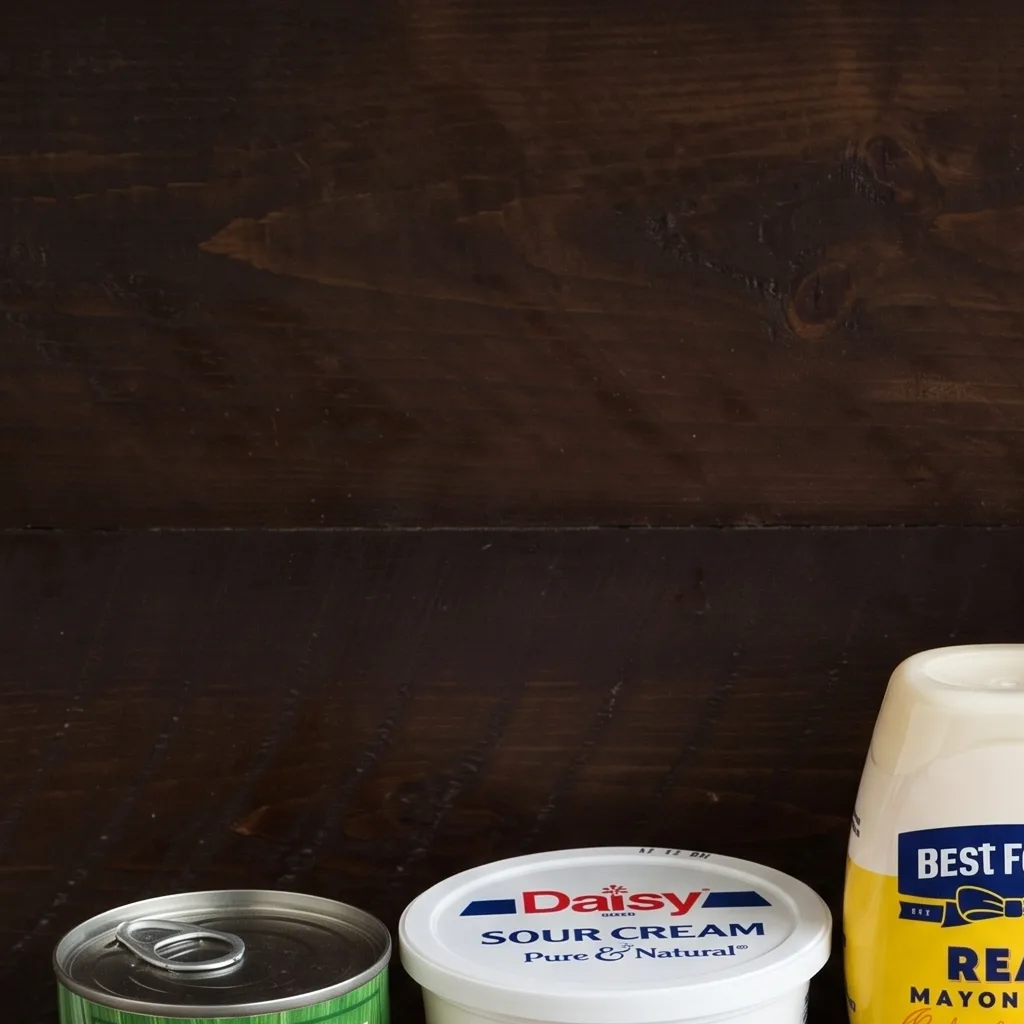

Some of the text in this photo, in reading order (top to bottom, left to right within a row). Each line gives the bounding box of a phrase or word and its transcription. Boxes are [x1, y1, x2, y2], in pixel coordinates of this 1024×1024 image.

[522, 886, 702, 916] Daisy
[481, 922, 765, 945] SOUR CREAM
[524, 951, 589, 963] Pure
[636, 945, 735, 959] Natural
